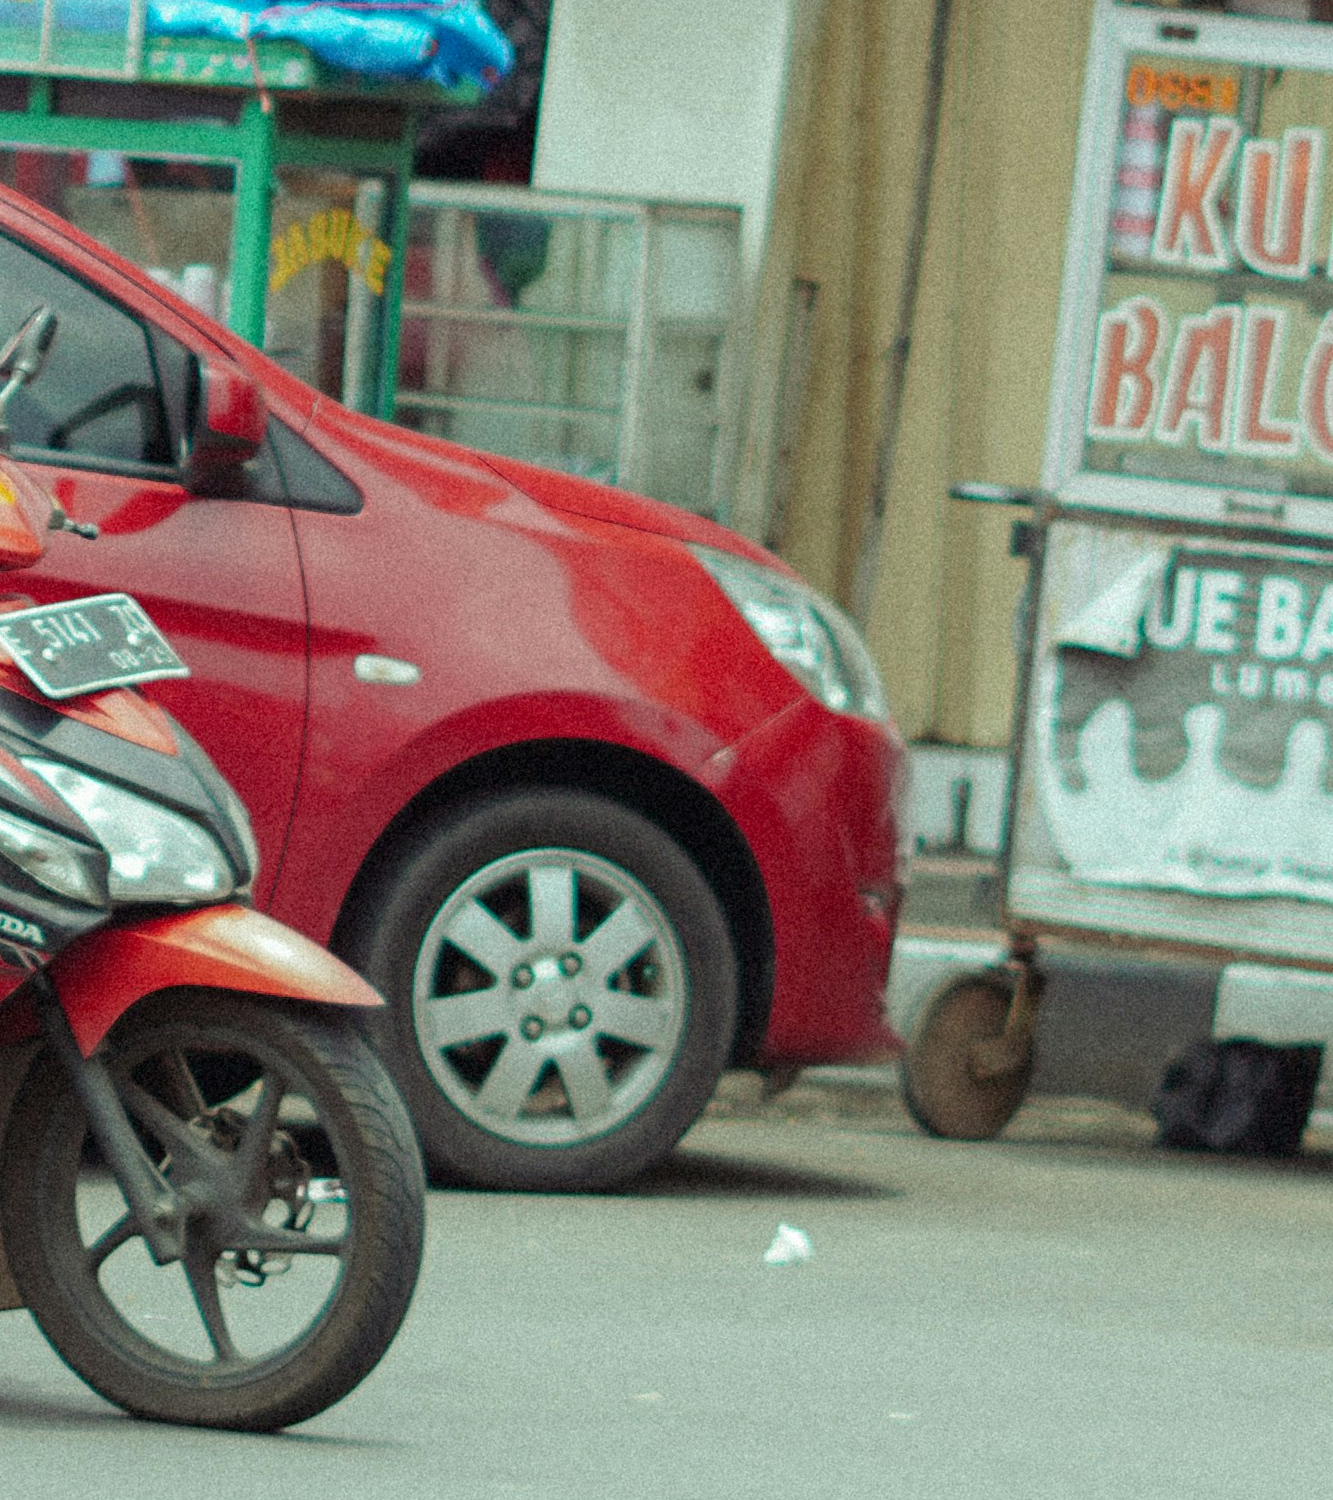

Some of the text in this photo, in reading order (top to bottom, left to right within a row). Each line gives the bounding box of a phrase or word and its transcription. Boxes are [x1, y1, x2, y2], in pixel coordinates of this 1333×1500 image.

[1153, 117, 1333, 281] KU
[269, 206, 392, 296] JASUKE
[31, 611, 103, 650] 5141
